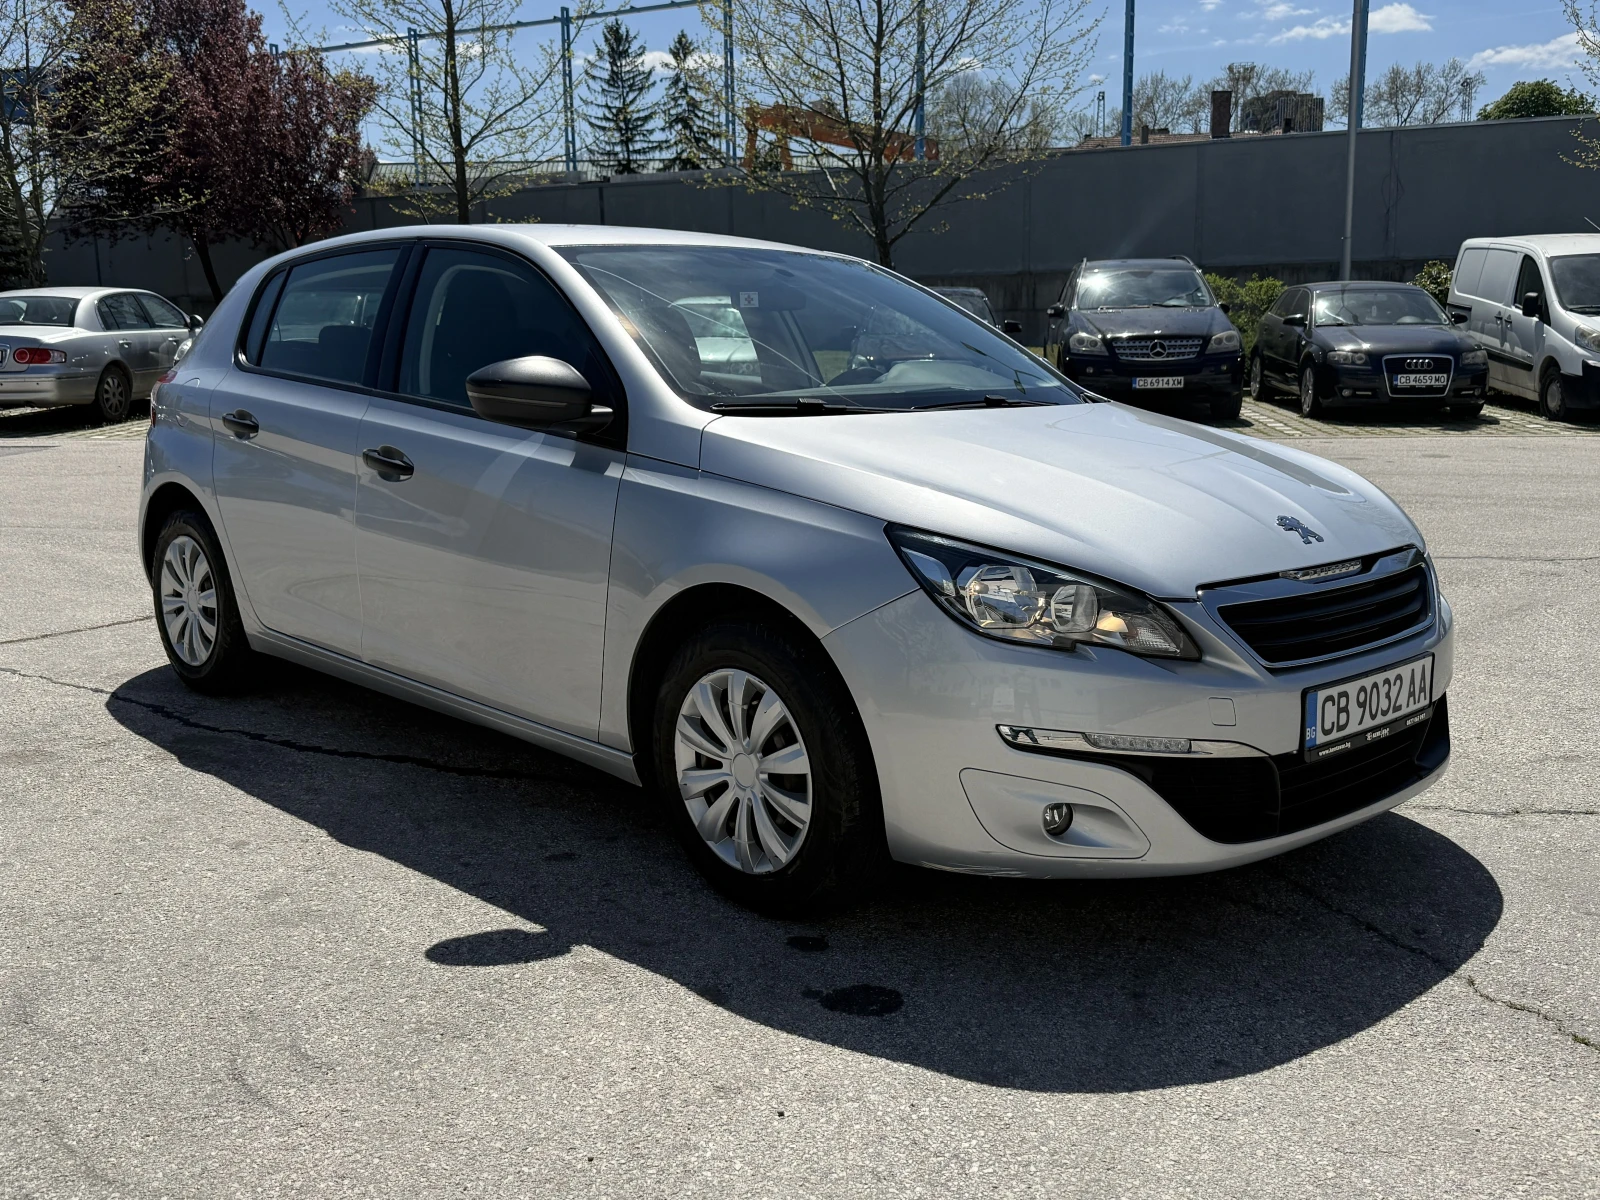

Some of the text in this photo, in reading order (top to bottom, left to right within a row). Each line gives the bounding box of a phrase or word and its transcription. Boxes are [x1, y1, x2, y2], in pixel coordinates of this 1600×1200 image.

[1137, 379, 1149, 387] CB
[1149, 378, 1170, 387] 6914
[1399, 375, 1411, 384] CB
[1412, 375, 1433, 384] 4659
[1320, 664, 1427, 737] CB 9032 AA
[1305, 726, 1316, 740] BG
